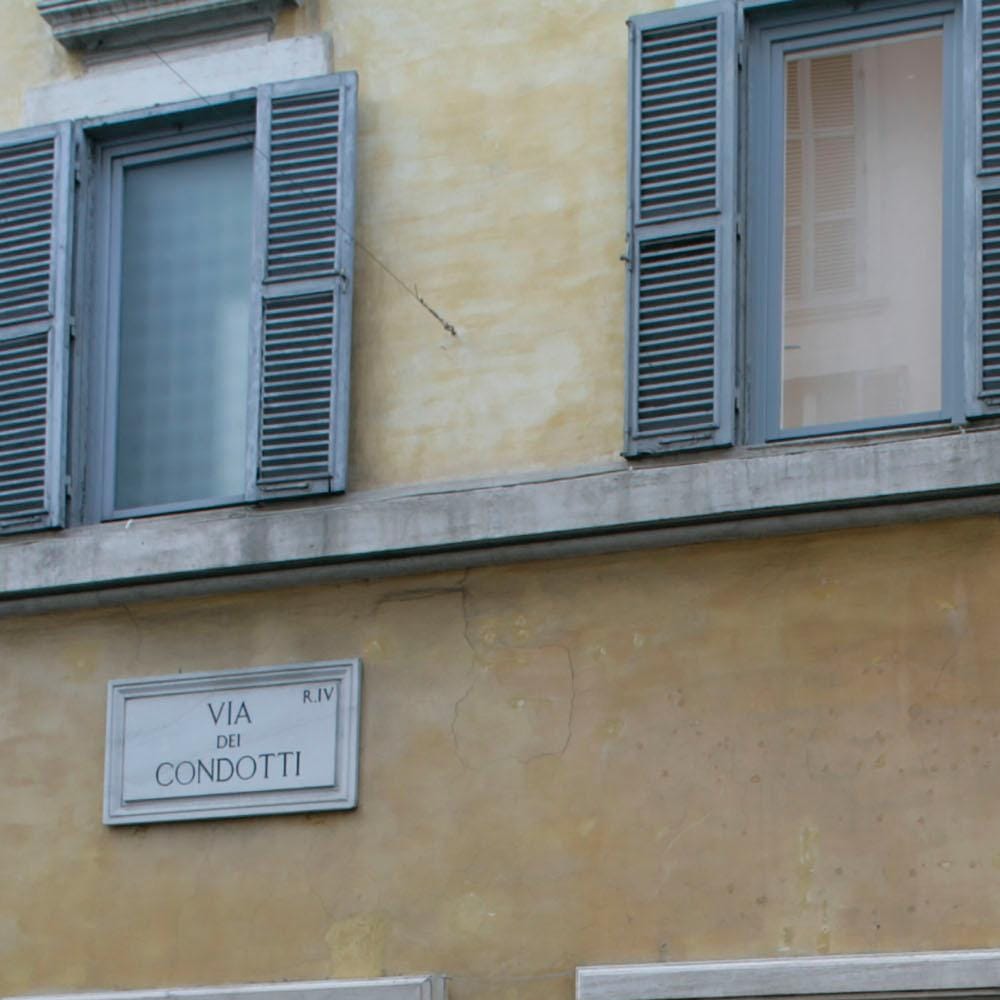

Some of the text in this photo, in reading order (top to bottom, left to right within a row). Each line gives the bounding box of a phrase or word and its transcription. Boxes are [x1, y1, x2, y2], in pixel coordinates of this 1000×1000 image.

[302, 687, 335, 704] R.IV
[207, 701, 252, 726] VIA
[216, 733, 241, 749] DEI
[155, 751, 302, 787] CONDOTTI
